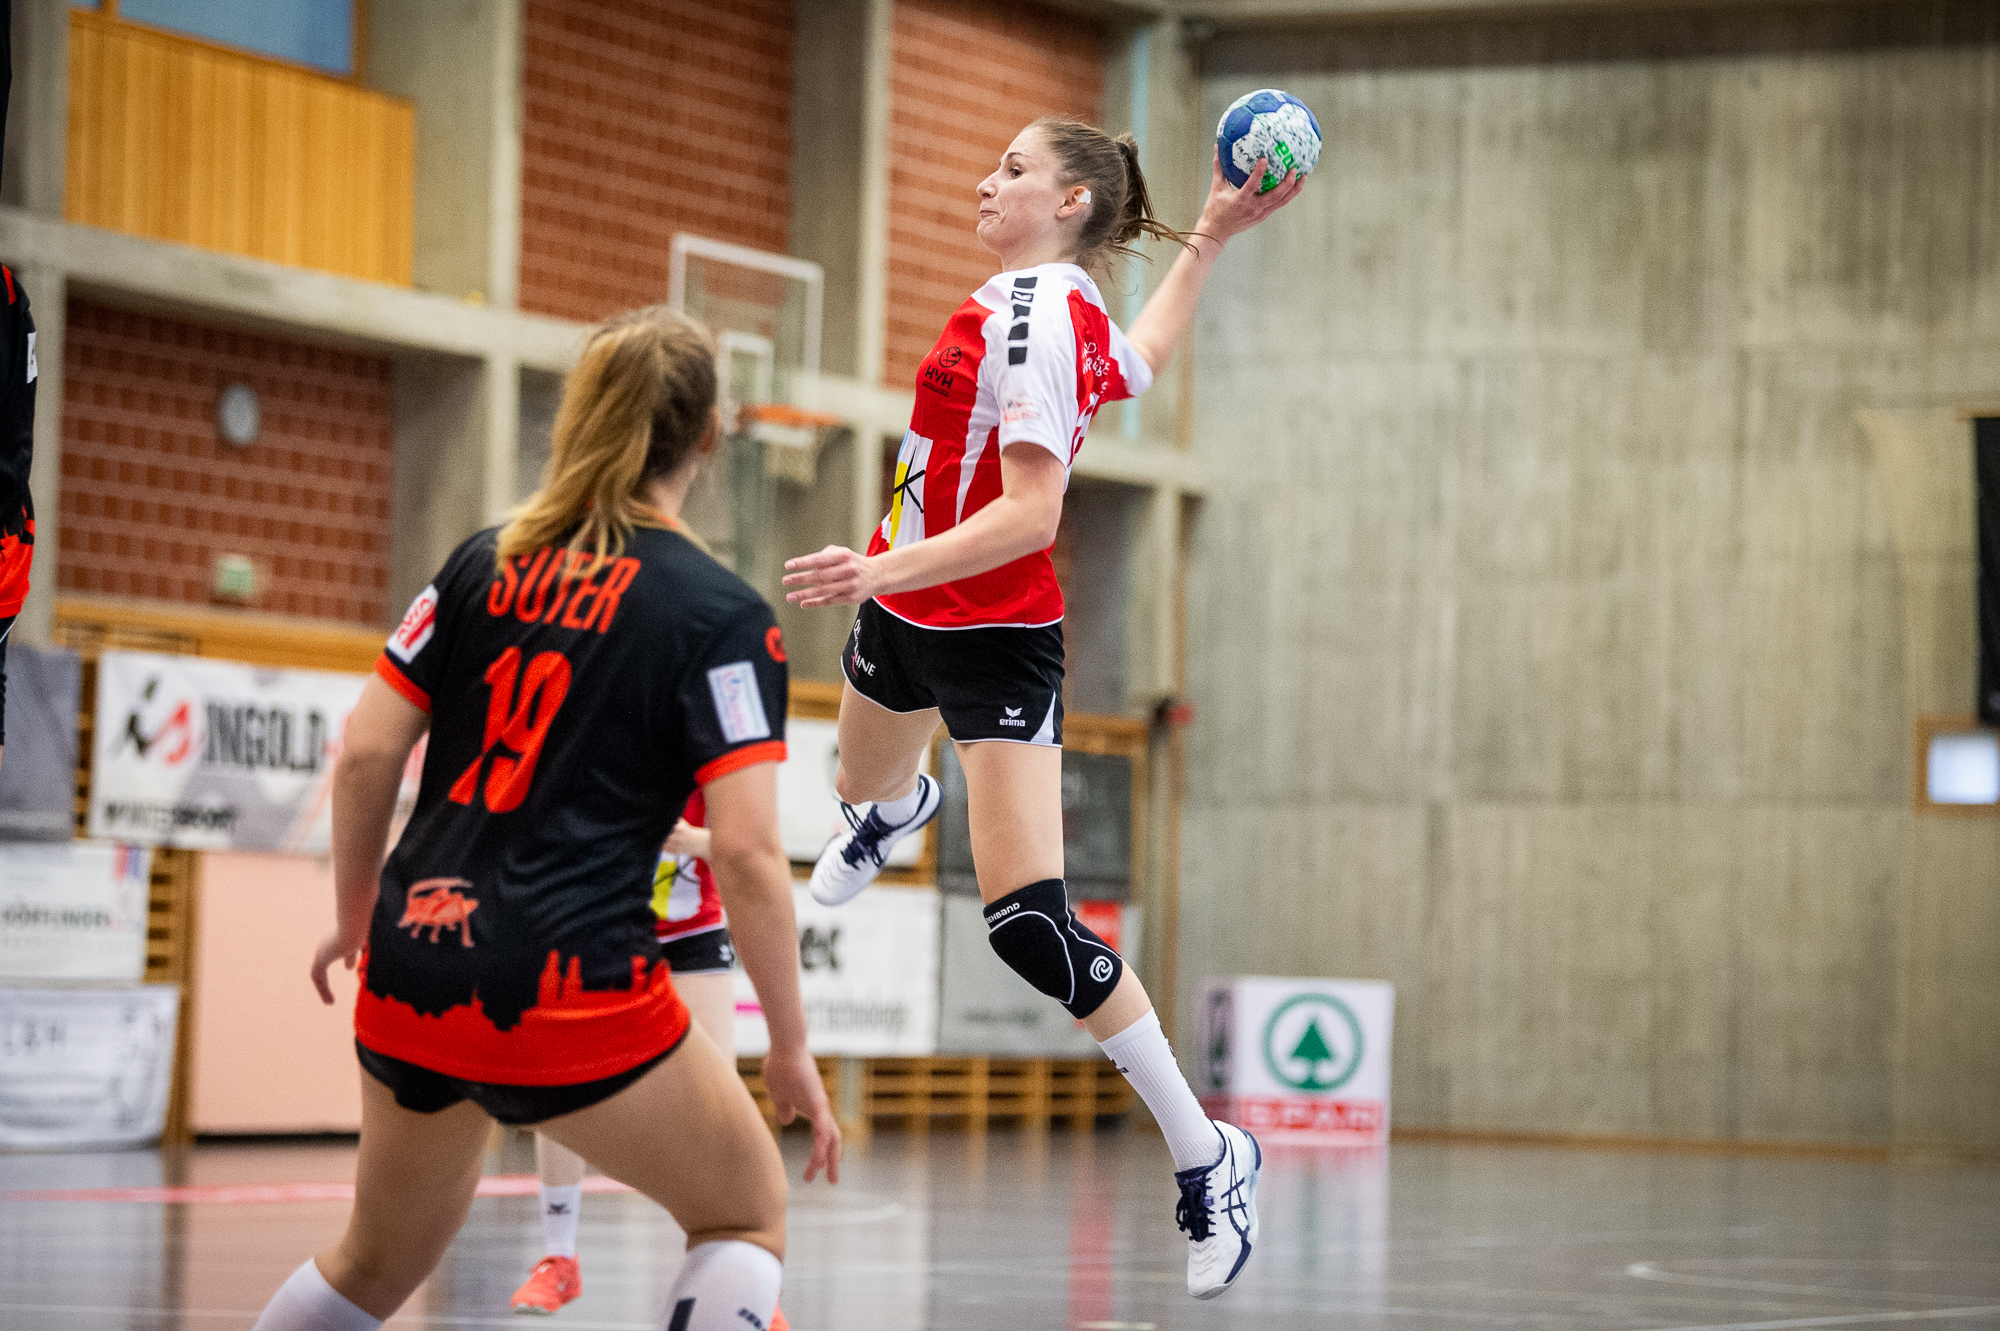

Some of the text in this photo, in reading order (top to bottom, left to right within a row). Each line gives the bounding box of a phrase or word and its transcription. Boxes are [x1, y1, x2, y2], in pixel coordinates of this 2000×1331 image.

[924, 364, 954, 389] HVH
[486, 546, 641, 635] SUTER
[203, 698, 327, 774] INGOLD
[448, 646, 572, 814] 19
[999, 717, 1026, 727] erima
